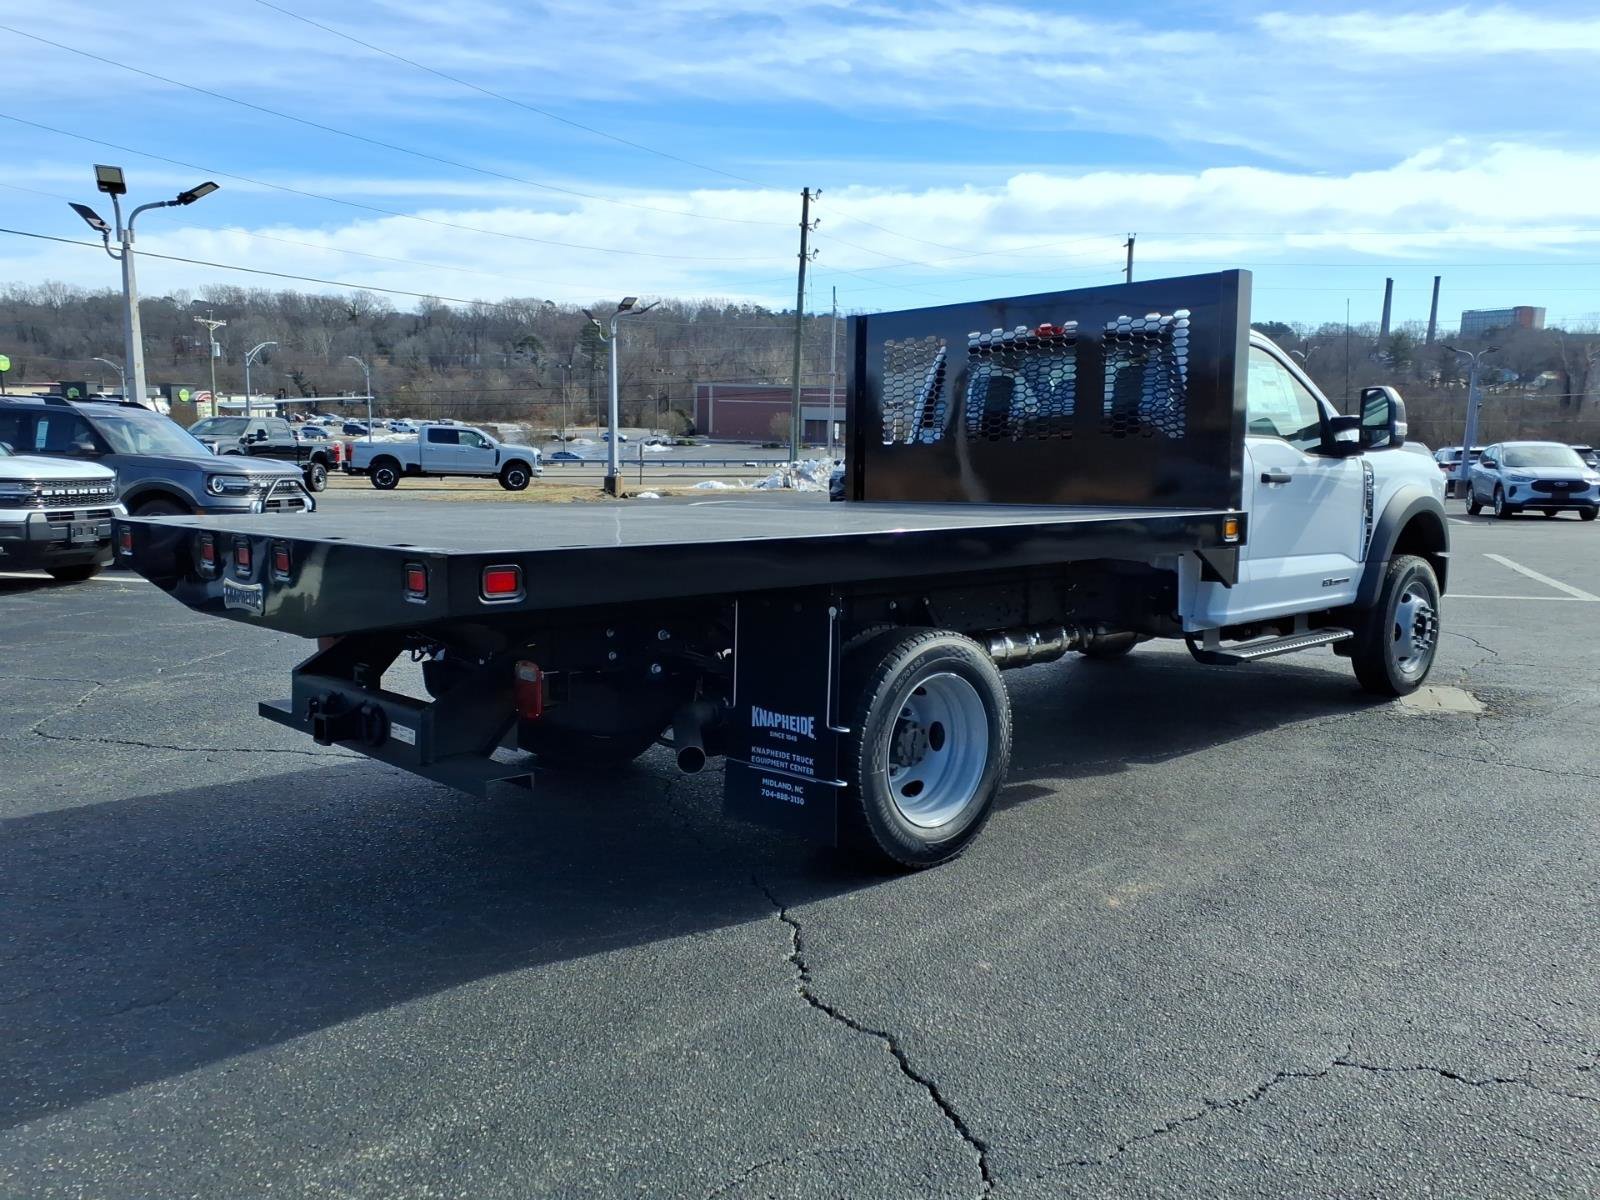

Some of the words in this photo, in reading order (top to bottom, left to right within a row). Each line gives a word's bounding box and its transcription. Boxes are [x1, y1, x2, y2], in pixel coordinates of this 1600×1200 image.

[41, 487, 108, 495] BRONCO
[752, 705, 815, 739] KNAPHEIDE
[751, 746, 791, 760] KNAPHEIDE
[792, 754, 814, 765] TRUCK
[751, 756, 788, 768] EQUIPMENT
[790, 763, 814, 775] CENTER
[762, 778, 794, 792] MIDLAND,
[794, 786, 804, 794] NC
